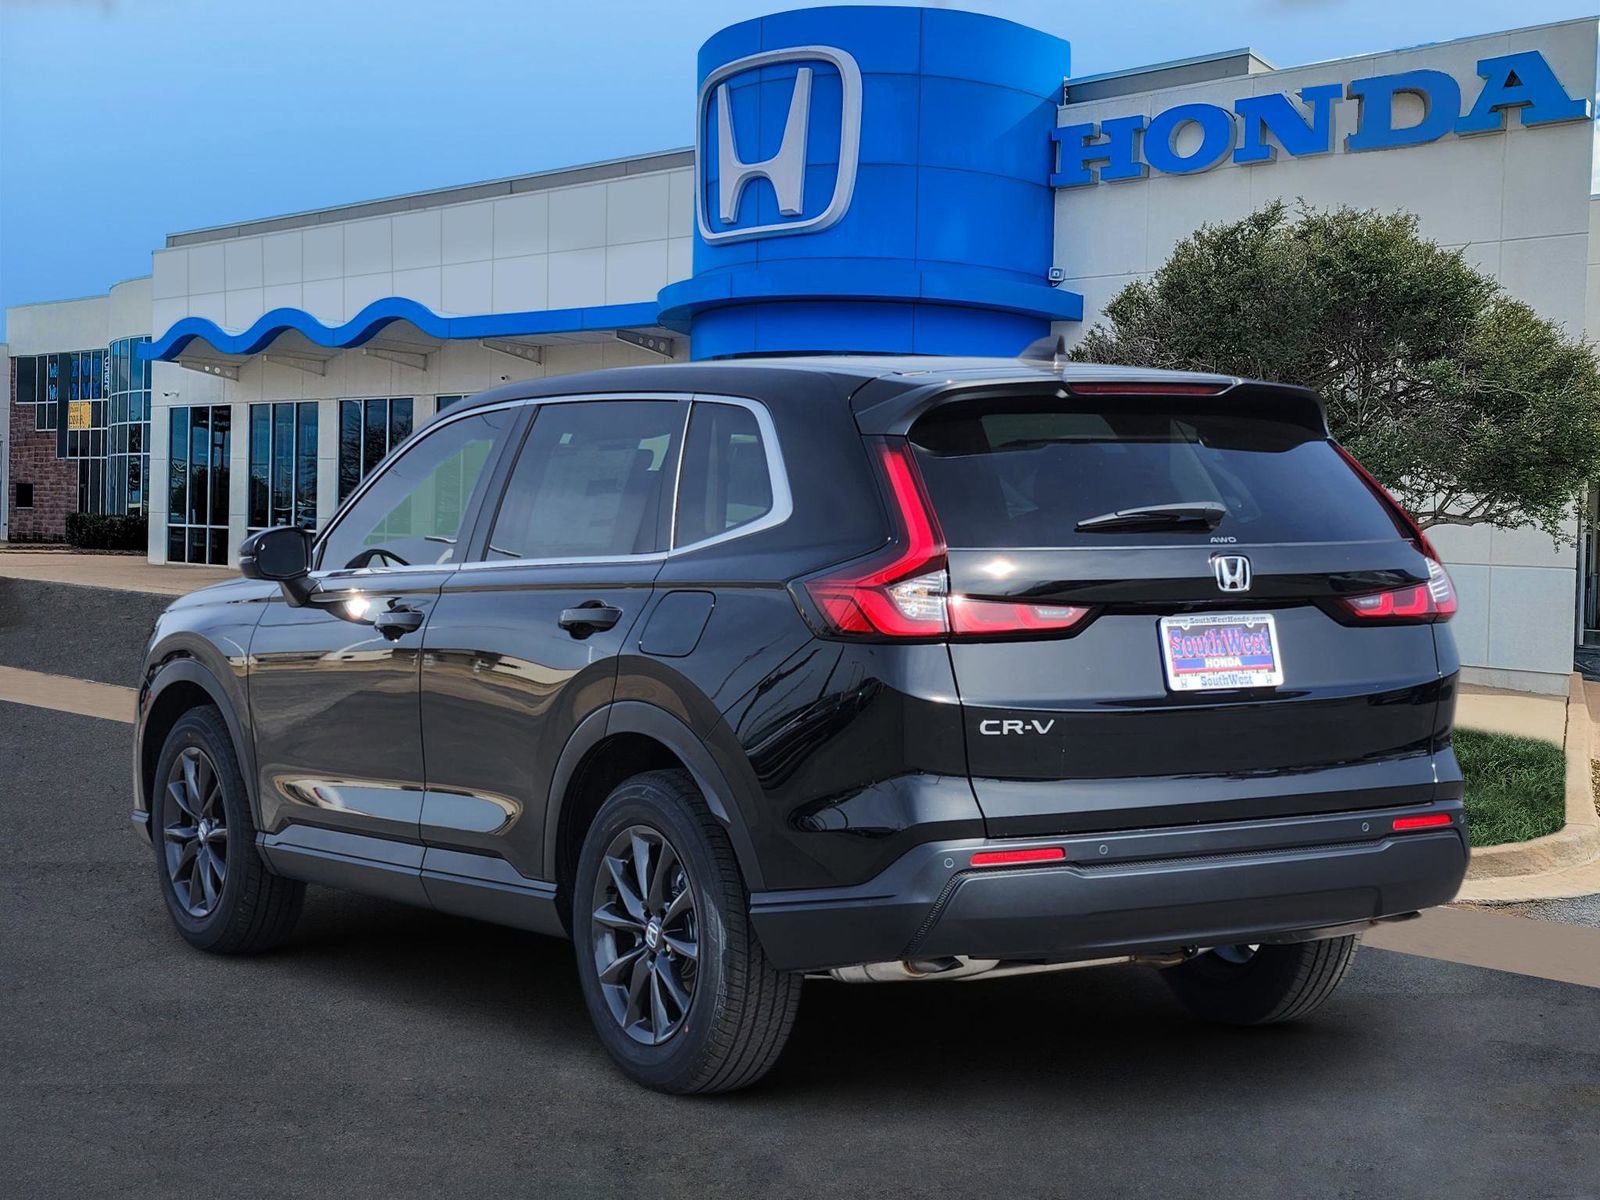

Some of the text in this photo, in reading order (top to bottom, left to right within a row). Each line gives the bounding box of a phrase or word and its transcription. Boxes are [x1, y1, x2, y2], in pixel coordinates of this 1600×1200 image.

[1050, 50, 1591, 187] HONDA
[1210, 536, 1237, 544] AWD
[1168, 627, 1271, 658] SouthWest
[1204, 656, 1243, 668] HONDA
[1200, 674, 1254, 687] SouthWest
[979, 719, 1055, 736] CR-V
